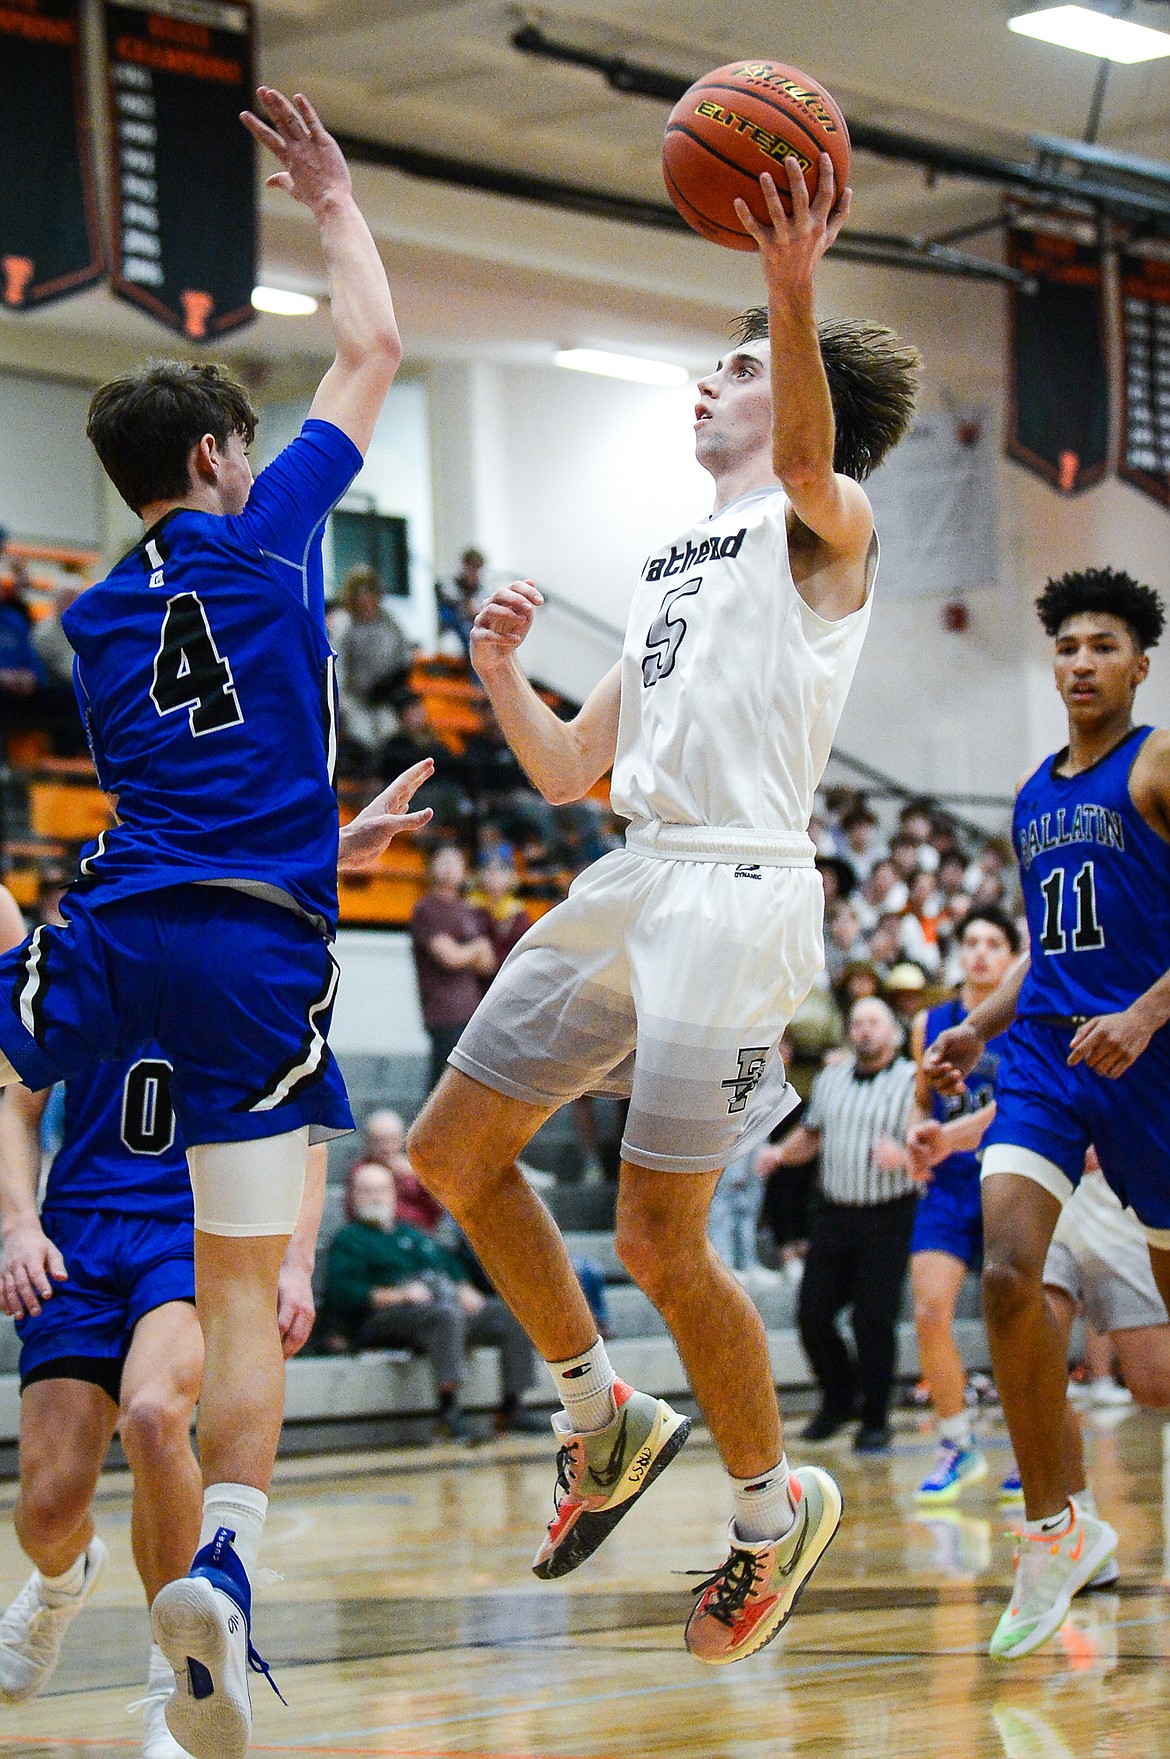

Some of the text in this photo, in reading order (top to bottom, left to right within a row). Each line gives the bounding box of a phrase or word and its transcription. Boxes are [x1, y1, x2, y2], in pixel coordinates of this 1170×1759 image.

[641, 528, 747, 582] athead
[150, 591, 244, 738] 4
[642, 577, 703, 688] 5
[734, 871, 762, 880] DYNAMIC
[1040, 861, 1105, 955] 11
[121, 1059, 176, 1155] 0
[212, 1530, 228, 1561] CURRY
